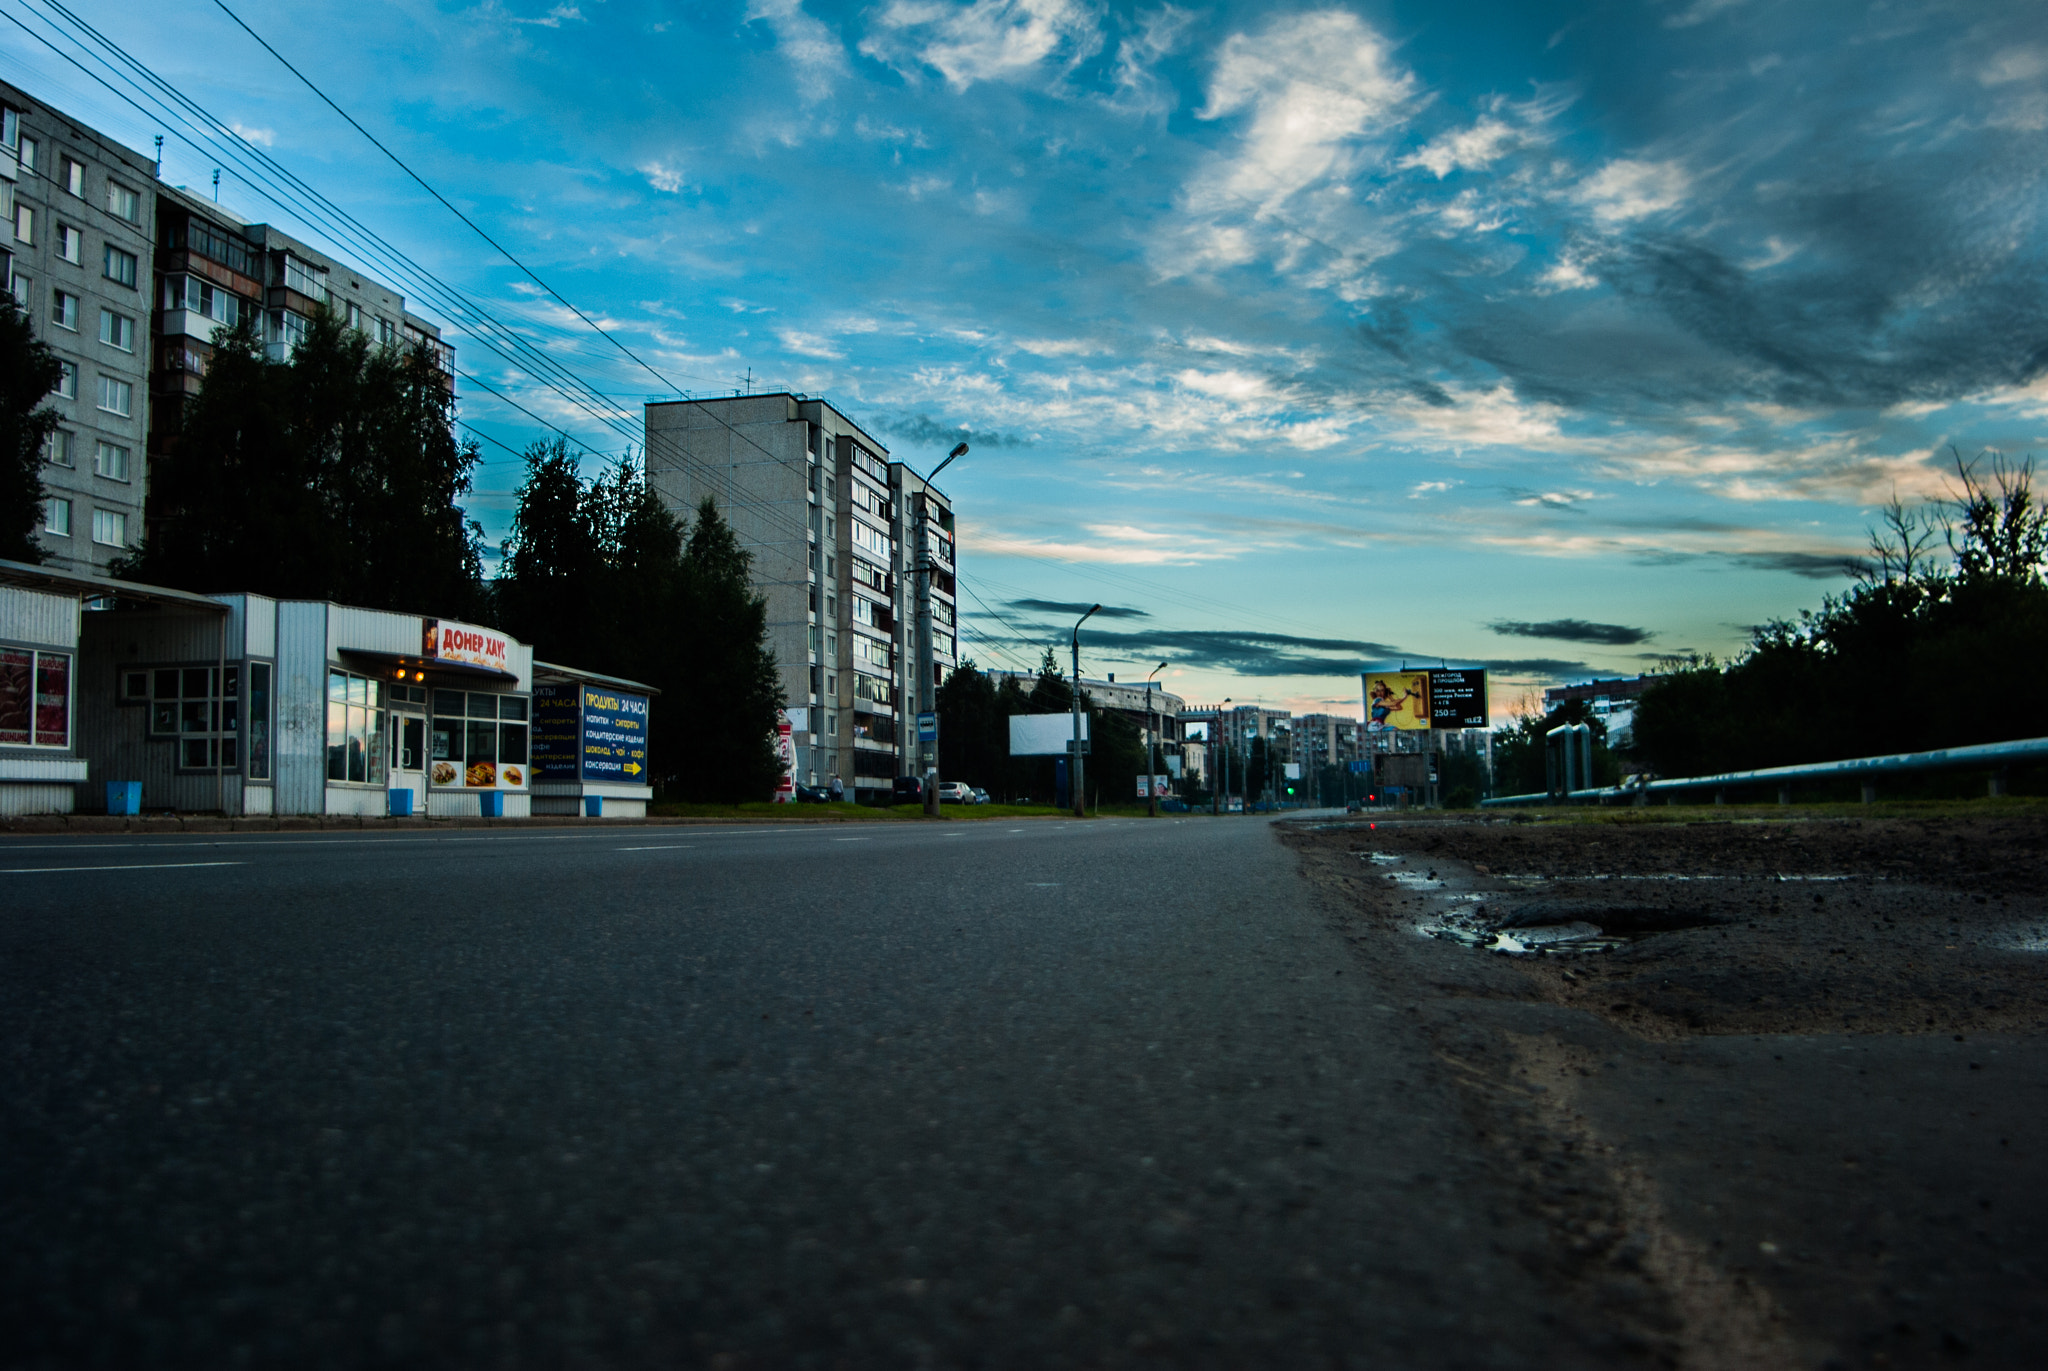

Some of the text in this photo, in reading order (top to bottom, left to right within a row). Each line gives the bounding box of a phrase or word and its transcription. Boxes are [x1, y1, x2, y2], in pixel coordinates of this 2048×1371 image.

[443, 628, 505, 660] ДОНЕР ХАУС
[540, 698, 578, 708] 24 ЧАСА
[585, 692, 646, 715] ПРОДУКТЫ 24 ЧАСА
[1433, 708, 1449, 717] 250
[586, 714, 640, 730] напитки сигареты
[1464, 715, 1483, 724] TELE2
[585, 729, 625, 742] кондитерские
[585, 745, 611, 756] шоколад
[585, 759, 622, 772] консервация
